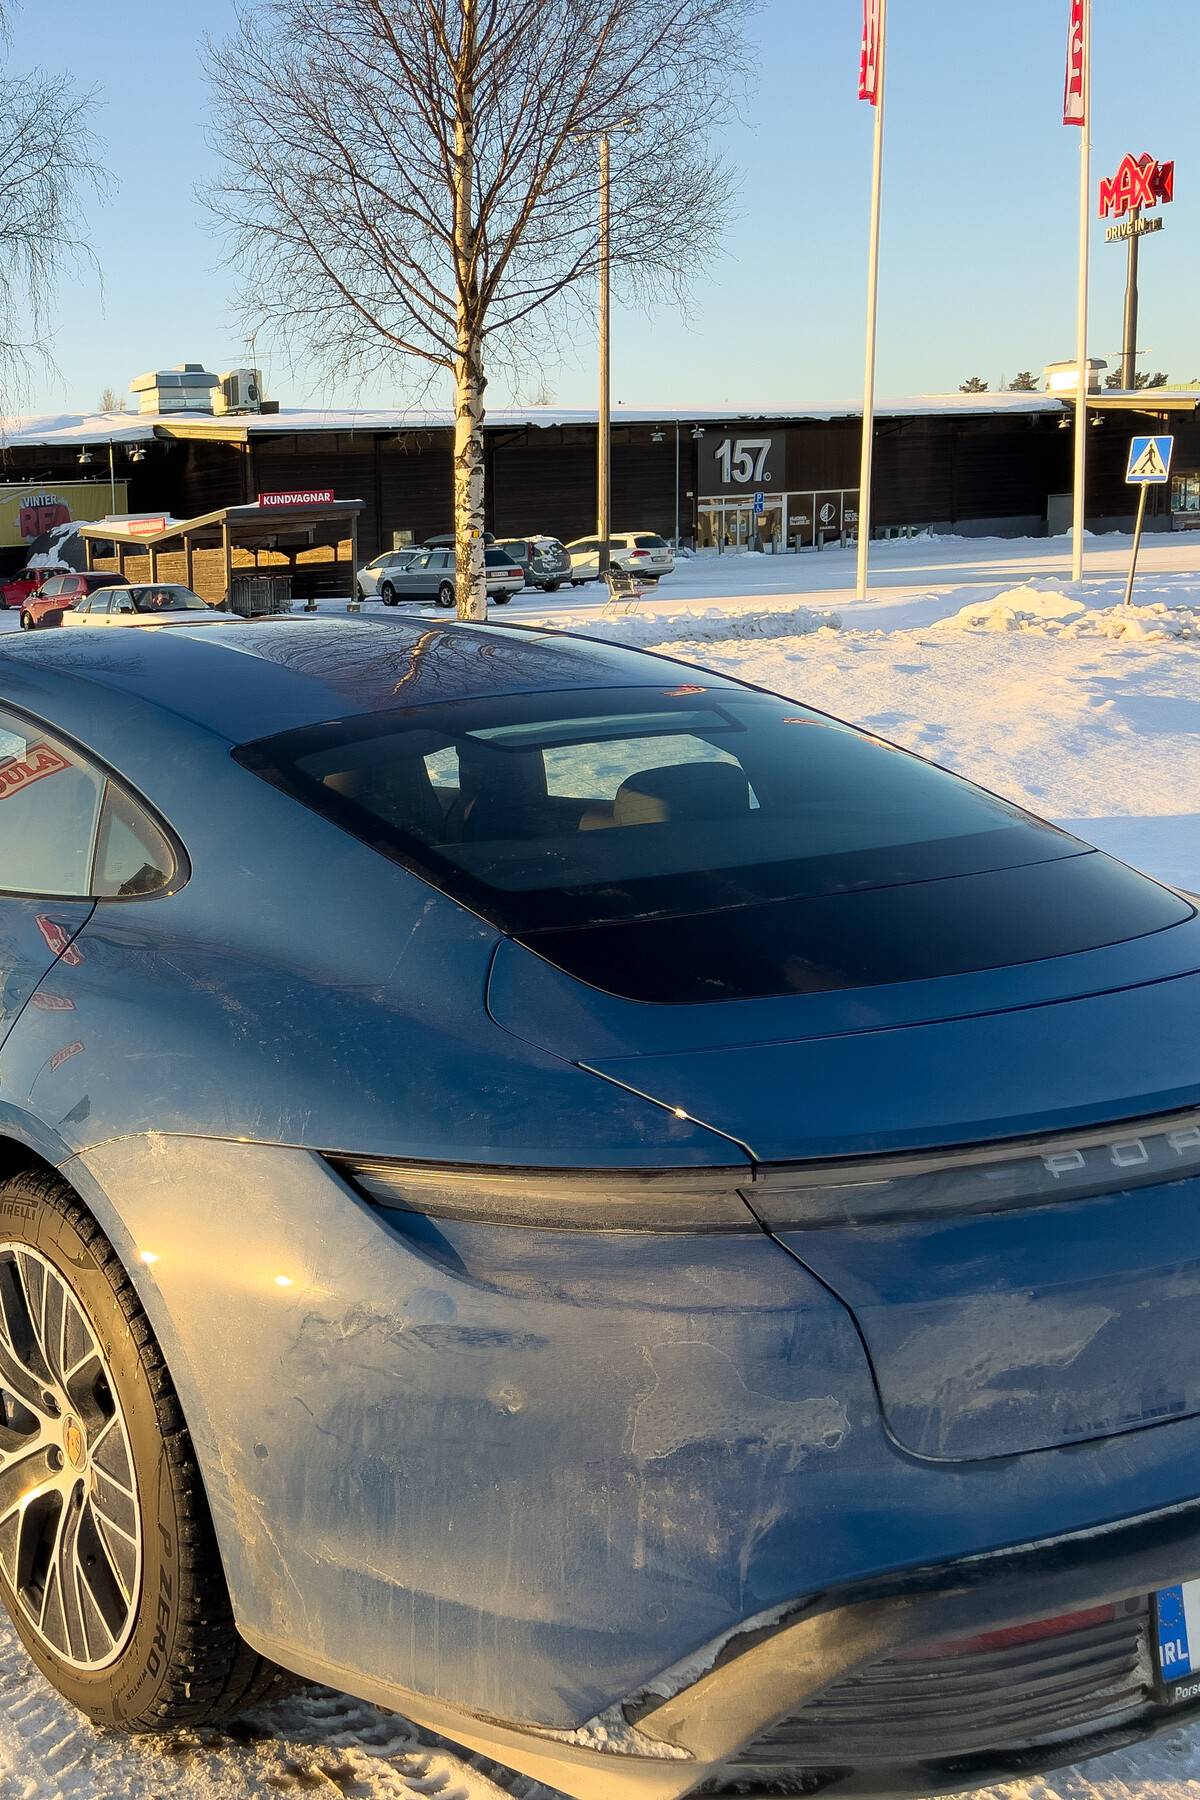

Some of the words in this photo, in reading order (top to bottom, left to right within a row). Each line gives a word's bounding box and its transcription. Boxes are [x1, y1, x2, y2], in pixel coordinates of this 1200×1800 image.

[1097, 152, 1156, 219] MAX
[1105, 221, 1133, 241] DRIVE
[1135, 217, 1145, 232] IN
[23, 495, 57, 507] VINTER
[263, 492, 331, 505] KUNDVAGNAR
[0, 1195, 39, 1221] PIRELLI
[146, 1564, 172, 1680] ZERO
[1159, 1638, 1189, 1667] IRL
[126, 1669, 149, 1703] WINTER
[1175, 1684, 1200, 1701] Pors
